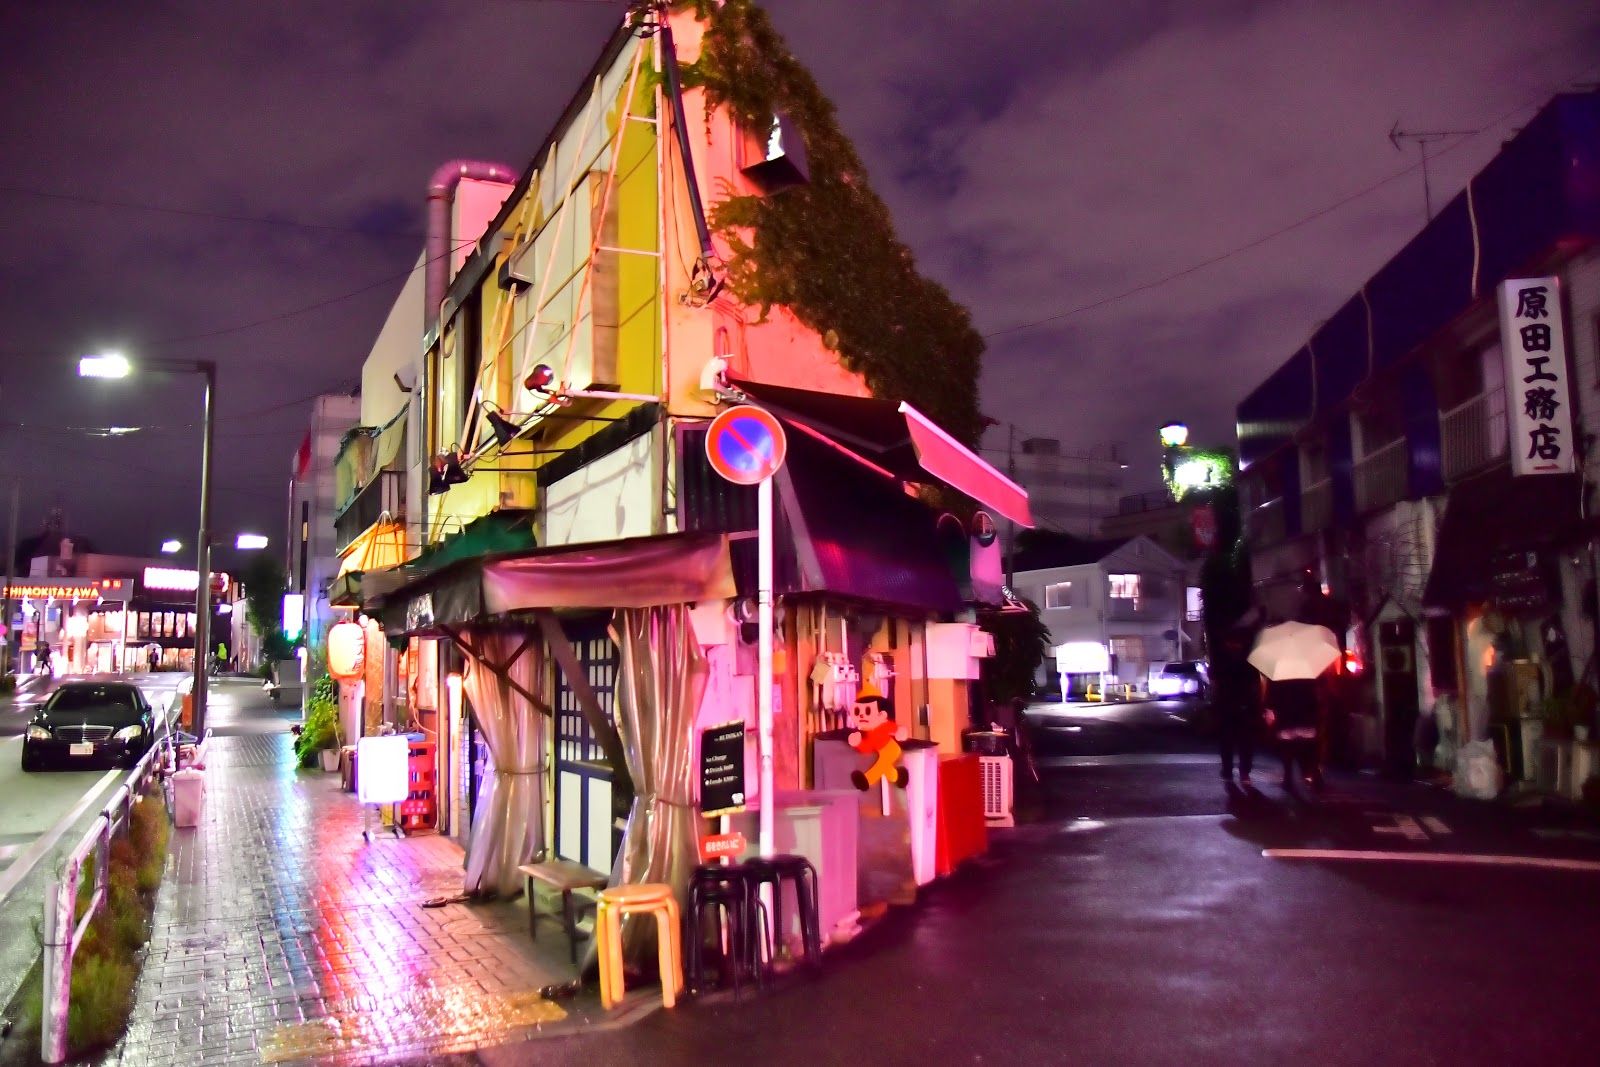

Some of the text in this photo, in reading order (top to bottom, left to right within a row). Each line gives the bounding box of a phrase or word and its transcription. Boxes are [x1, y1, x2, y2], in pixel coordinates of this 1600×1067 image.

[1515, 286, 1561, 460] 原田工務店
